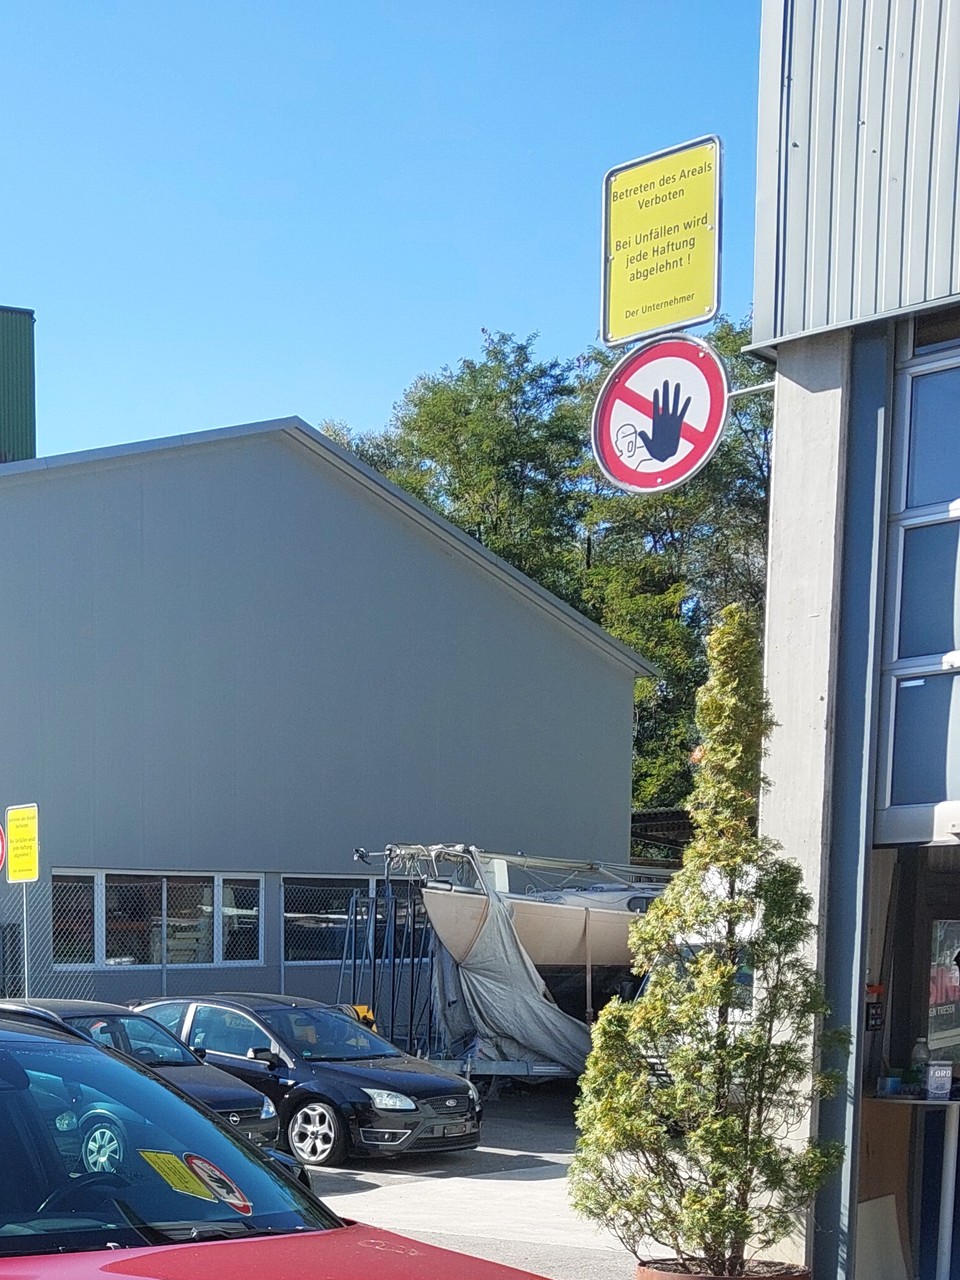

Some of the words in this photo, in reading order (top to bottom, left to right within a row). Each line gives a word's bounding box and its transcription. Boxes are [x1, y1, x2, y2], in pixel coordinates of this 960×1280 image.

[612, 181, 655, 202] Betreten
[659, 175, 676, 187] des
[678, 161, 712, 180] Areals
[637, 188, 685, 210] Verboten
[615, 236, 631, 251] Bei
[635, 224, 679, 245] Unfällen
[683, 213, 708, 230] wird
[625, 250, 648, 269] jede
[652, 237, 695, 258] Haftung
[629, 256, 683, 282] abgelehnt
[687, 253, 691, 265] !
[625, 308, 639, 319] Der
[641, 292, 695, 314] Unternehmer
[930, 1070, 951, 1078] FORD
